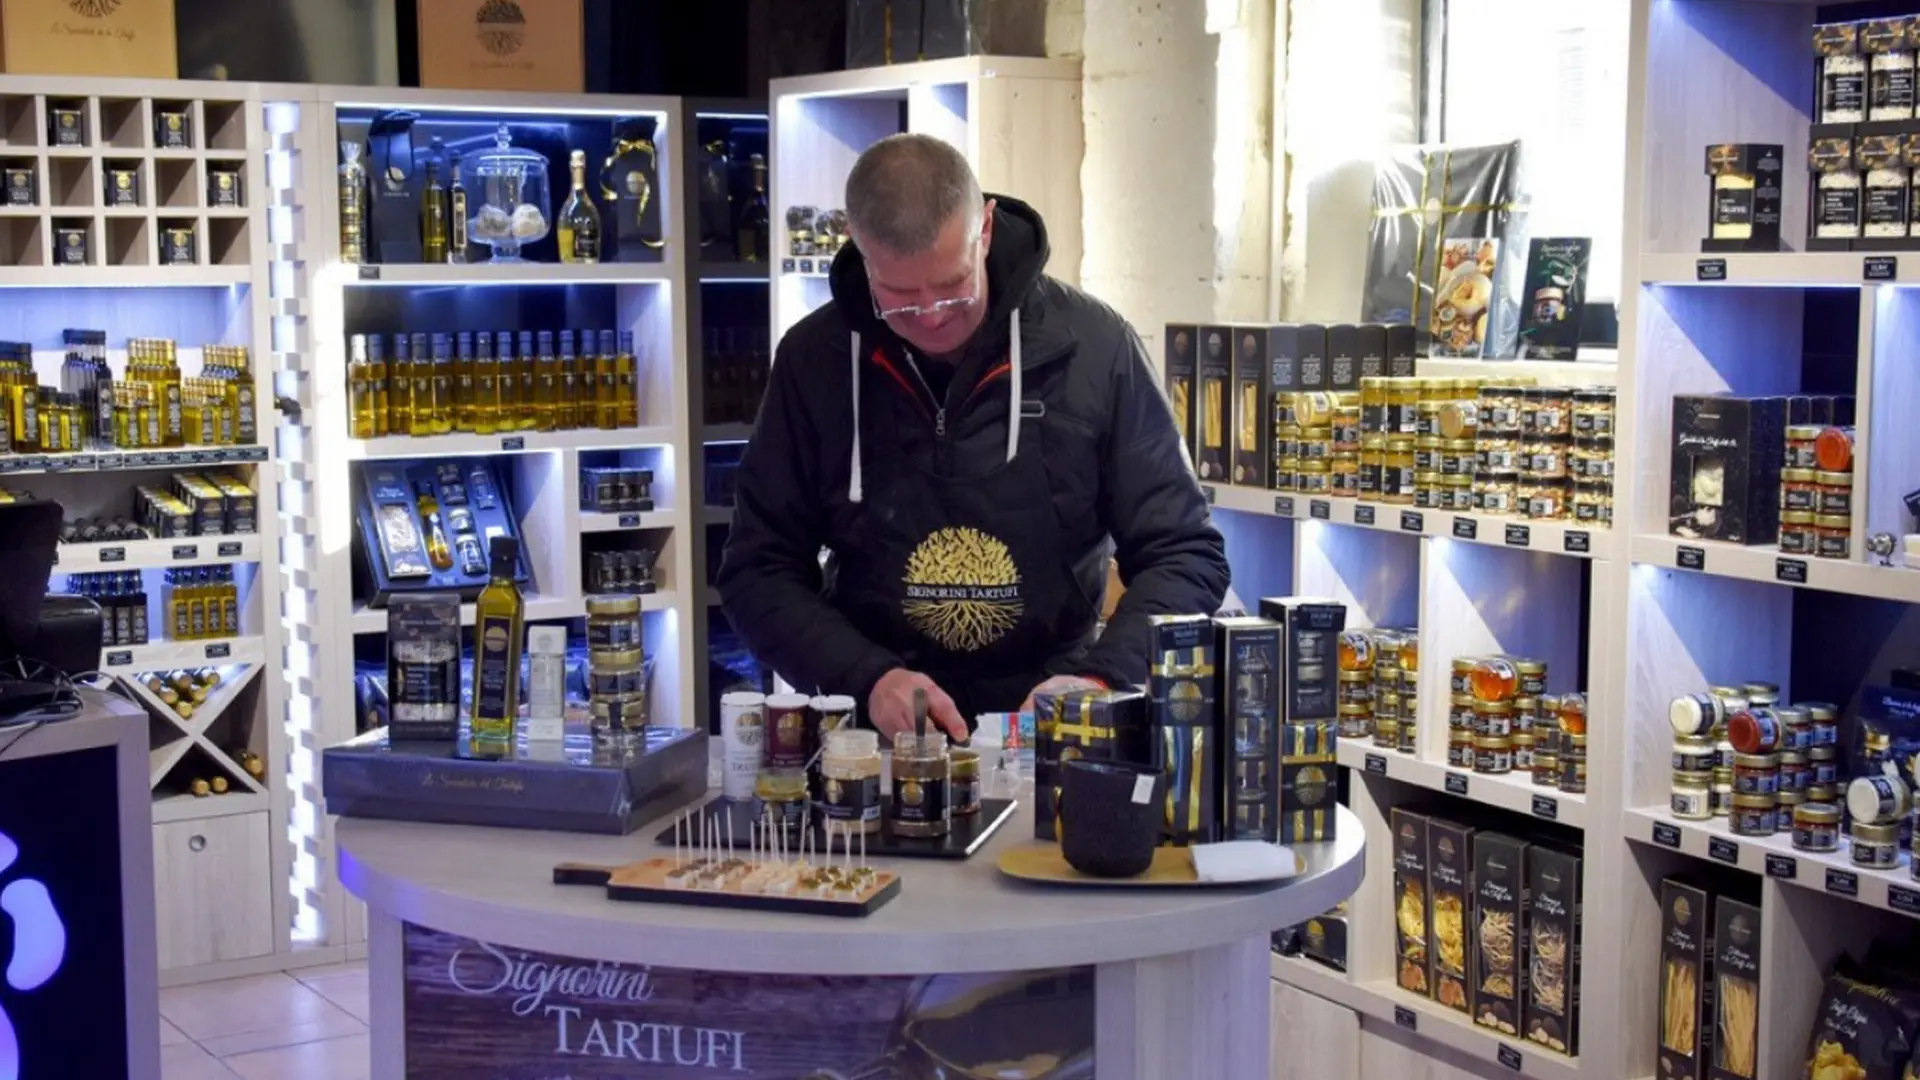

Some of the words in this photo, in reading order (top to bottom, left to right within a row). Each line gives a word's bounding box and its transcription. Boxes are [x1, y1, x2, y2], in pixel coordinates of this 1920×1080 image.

[906, 585, 967, 598] SIGNORINI
[970, 585, 1019, 599] TARTUFI
[448, 940, 654, 1016] Signorini
[544, 1004, 748, 1070] TARTUFI
